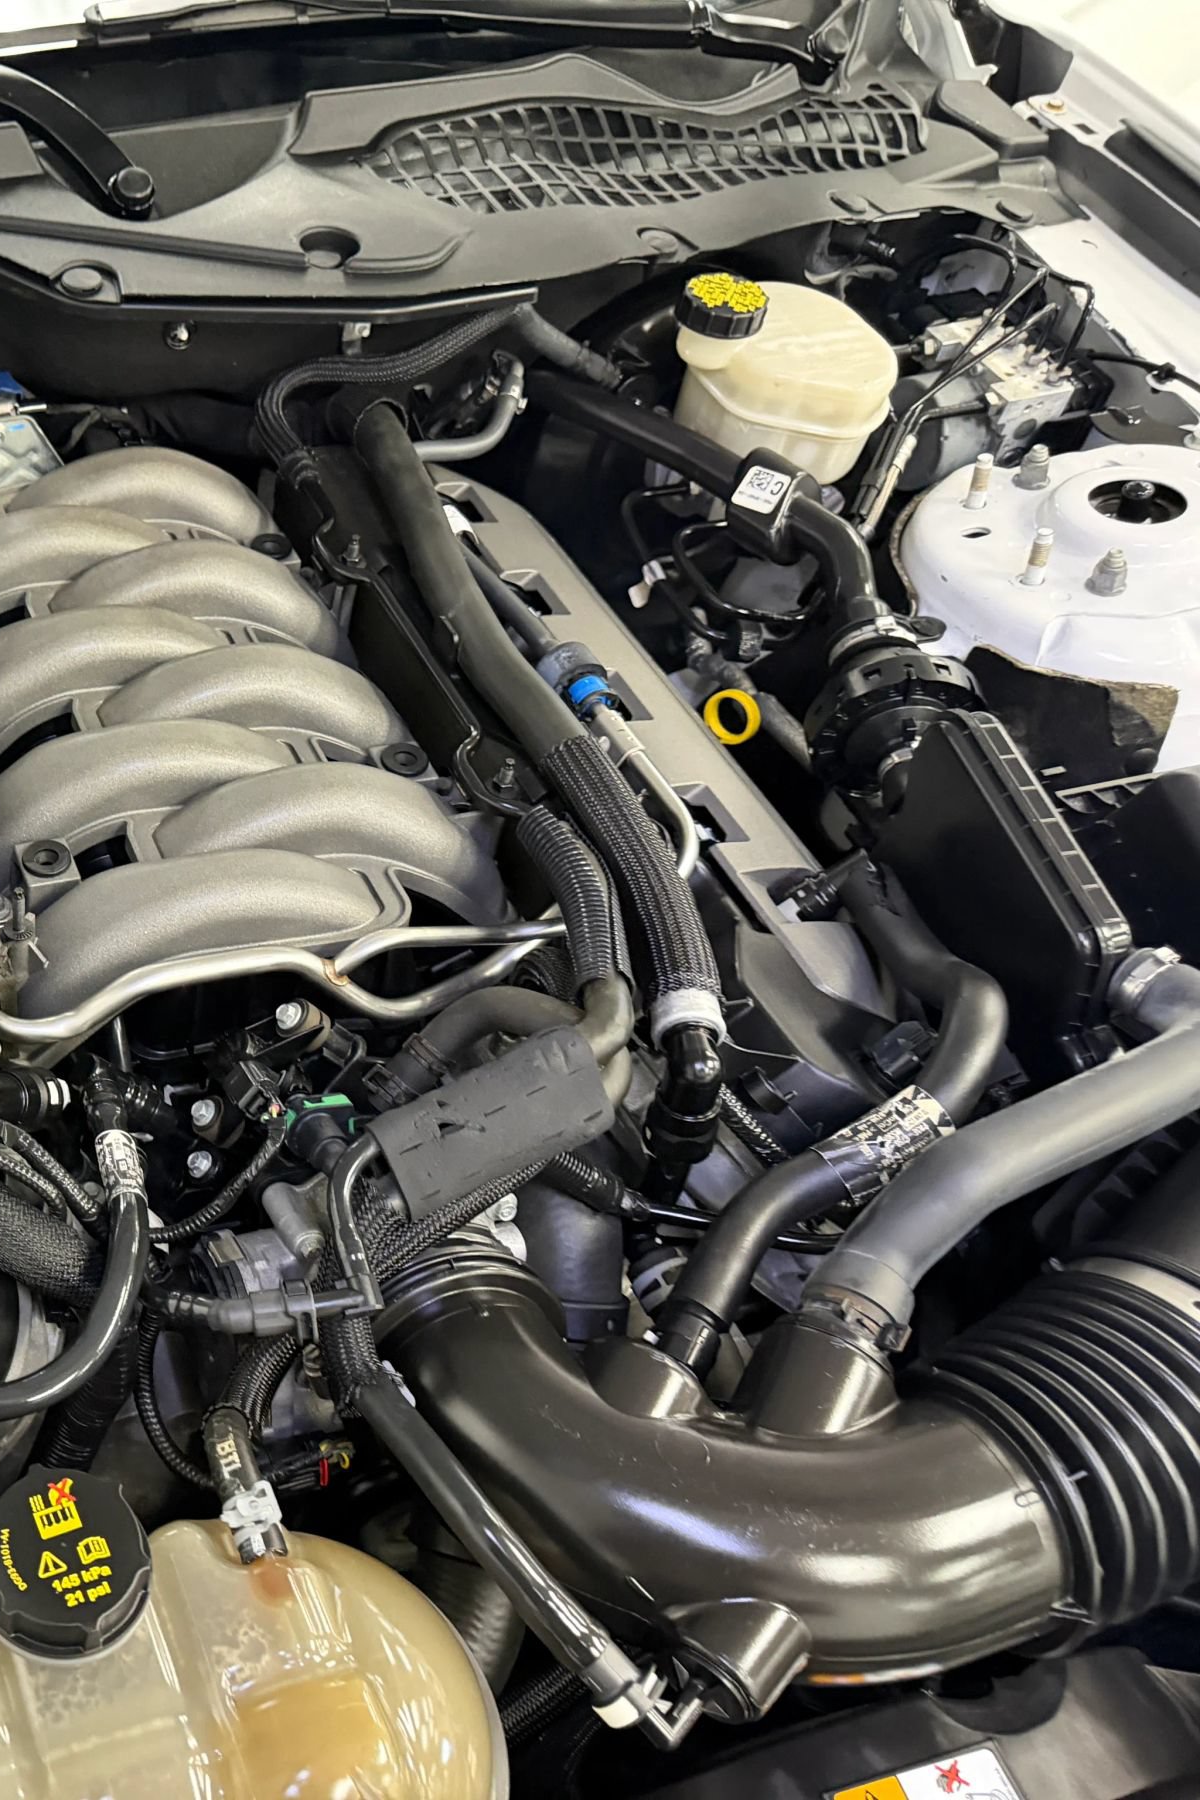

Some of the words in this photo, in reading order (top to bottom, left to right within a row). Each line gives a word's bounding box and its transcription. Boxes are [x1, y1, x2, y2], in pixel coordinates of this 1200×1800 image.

[52, 1573, 81, 1592] 145
[81, 1565, 112, 1583] kPa
[65, 1590, 85, 1608] 21
[87, 1581, 112, 1602] psi
